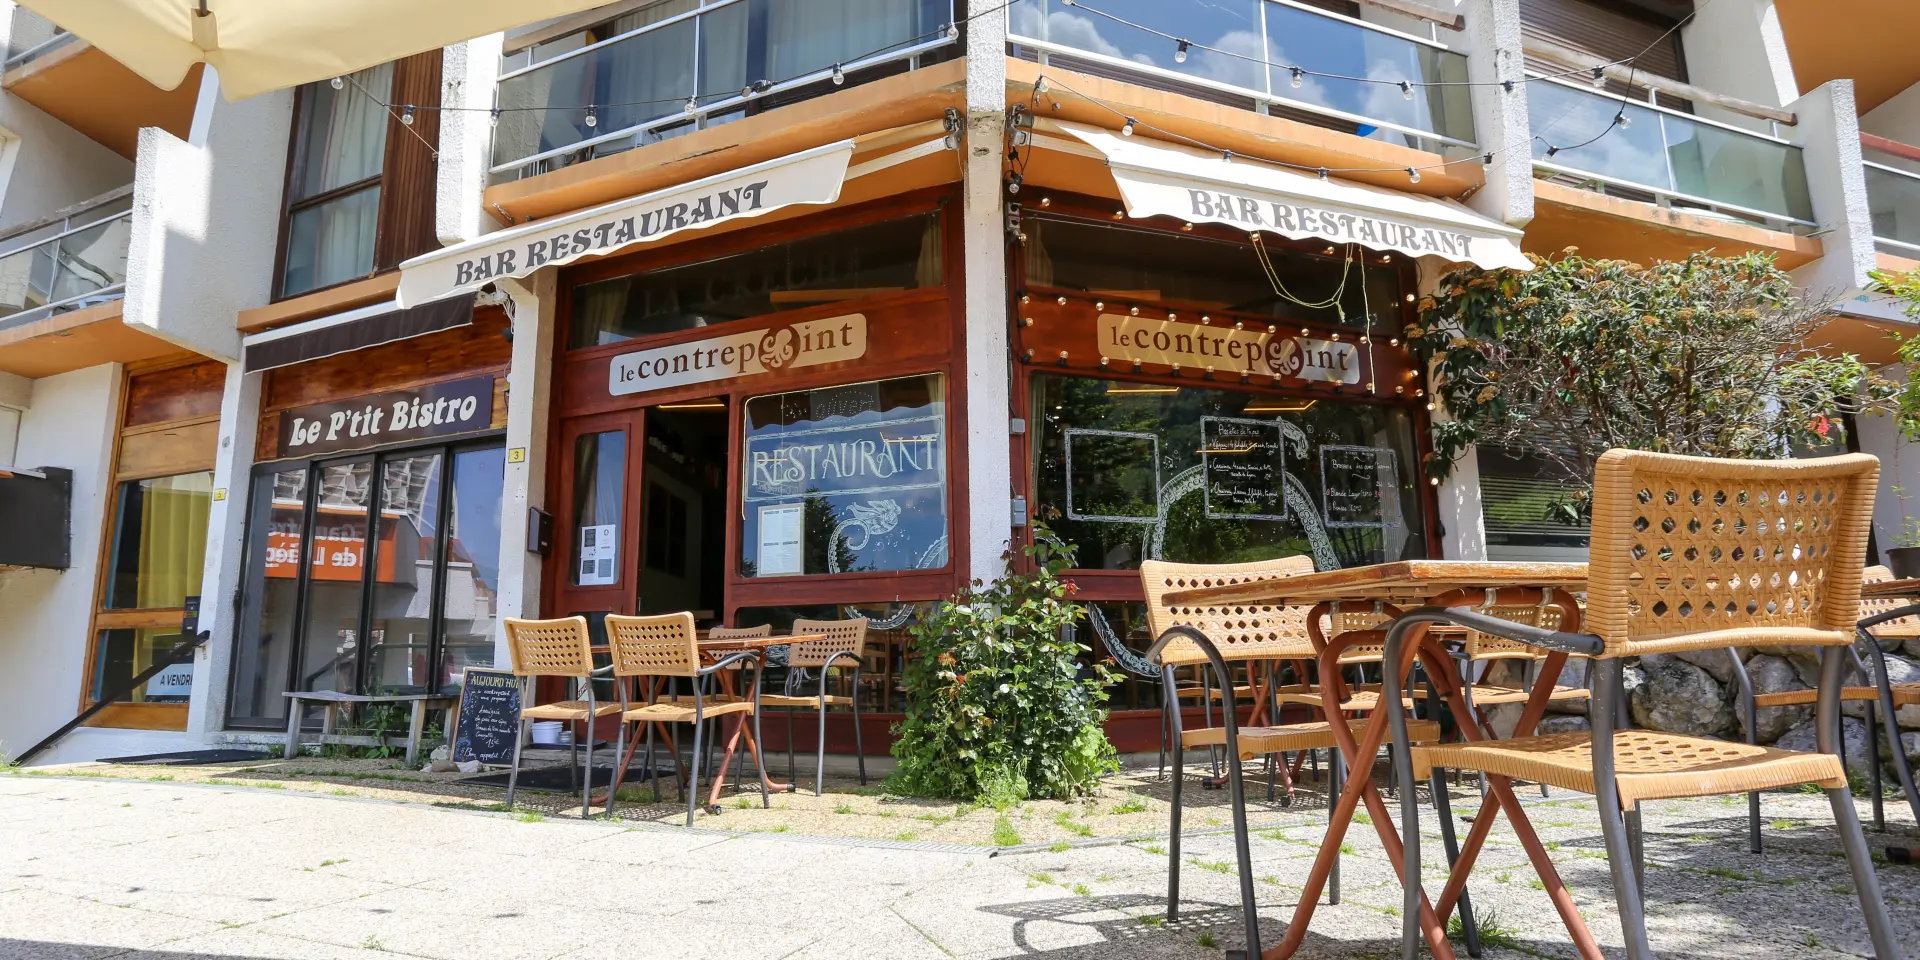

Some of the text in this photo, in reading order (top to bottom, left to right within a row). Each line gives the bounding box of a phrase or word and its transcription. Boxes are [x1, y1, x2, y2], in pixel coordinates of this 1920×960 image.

[453, 180, 769, 287] BAR RESTAURANT
[1188, 188, 1474, 258] BAR RESTAURANT
[1111, 326, 1130, 347] le
[619, 365, 635, 383] le
[289, 395, 477, 447] Le P'tit Bistro
[514, 450, 519, 460] 3
[752, 432, 939, 486] RESTAURANT
[160, 675, 166, 686] A
